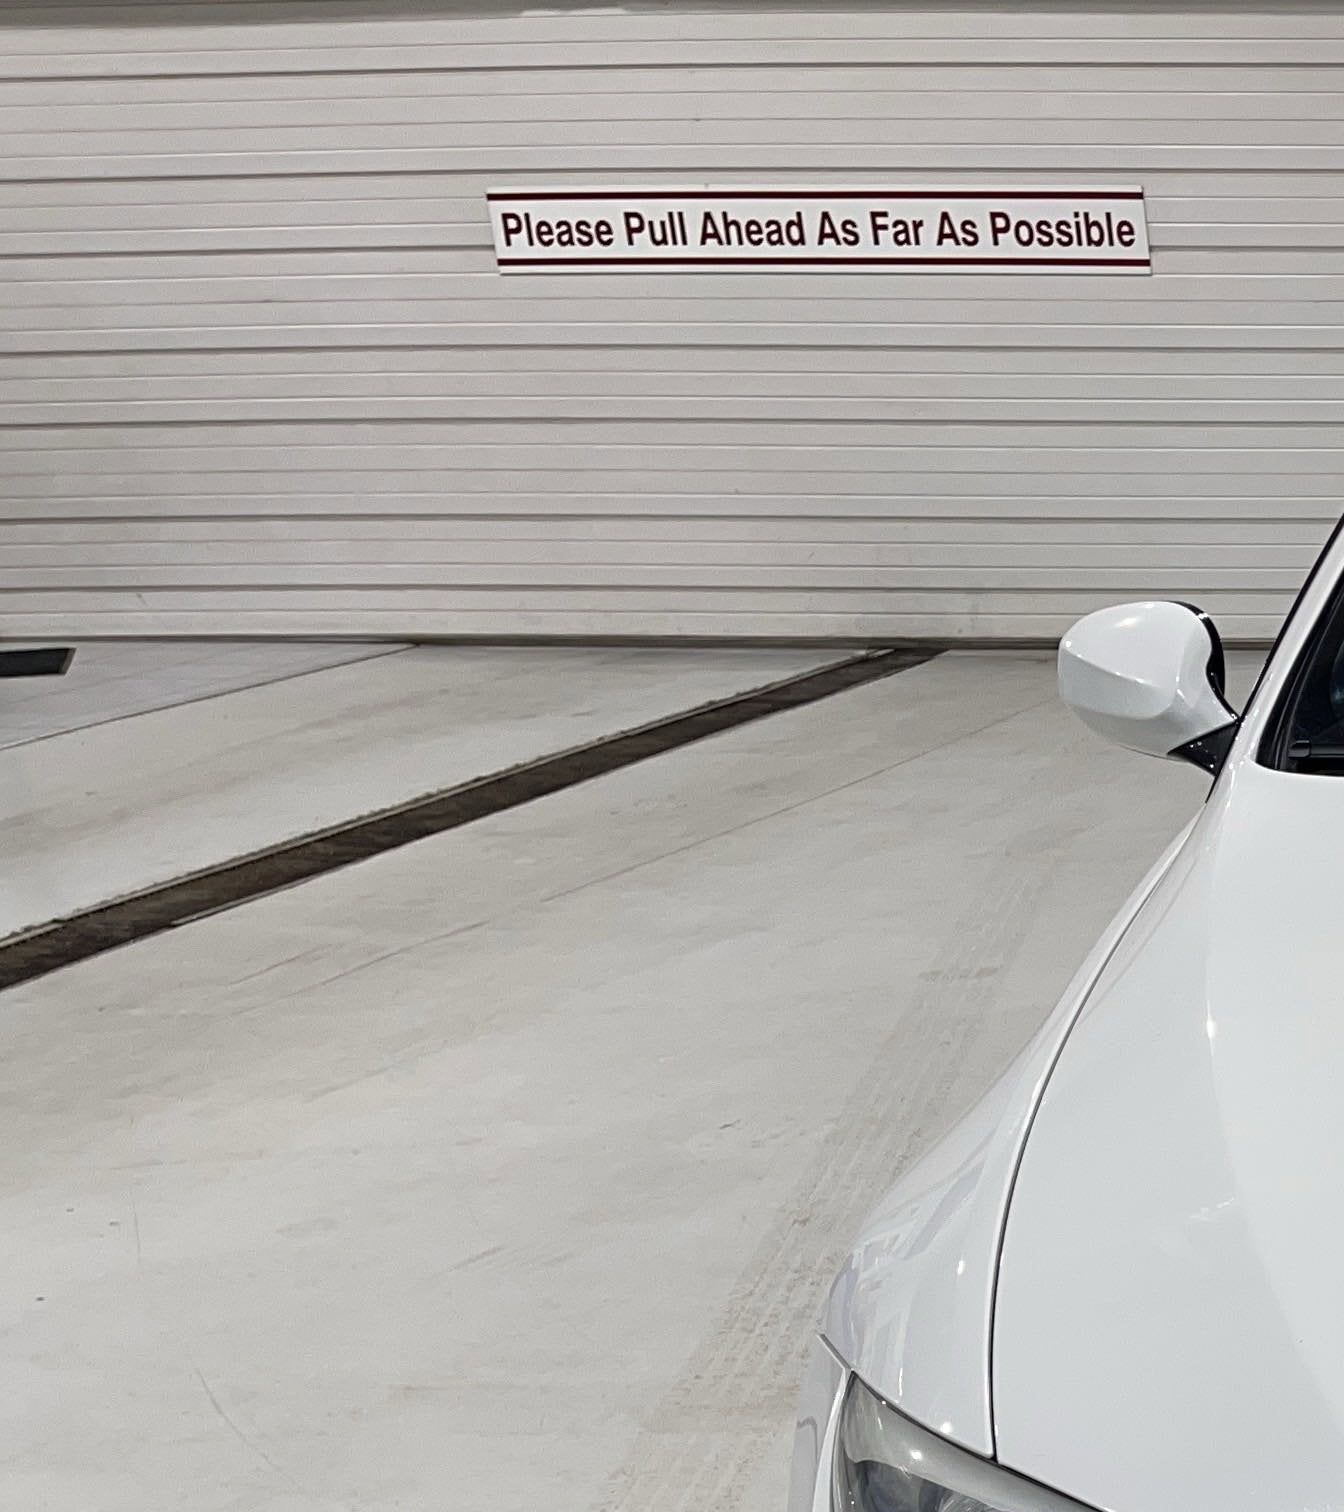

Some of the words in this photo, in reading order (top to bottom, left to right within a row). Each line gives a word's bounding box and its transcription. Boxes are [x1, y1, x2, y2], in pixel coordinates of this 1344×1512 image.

[502, 212, 614, 247] Please
[626, 211, 688, 247] Pull
[699, 211, 802, 248] Ahead
[818, 212, 860, 247] As
[872, 212, 925, 247] Far
[936, 212, 980, 247] As
[991, 212, 1136, 248] Possible
